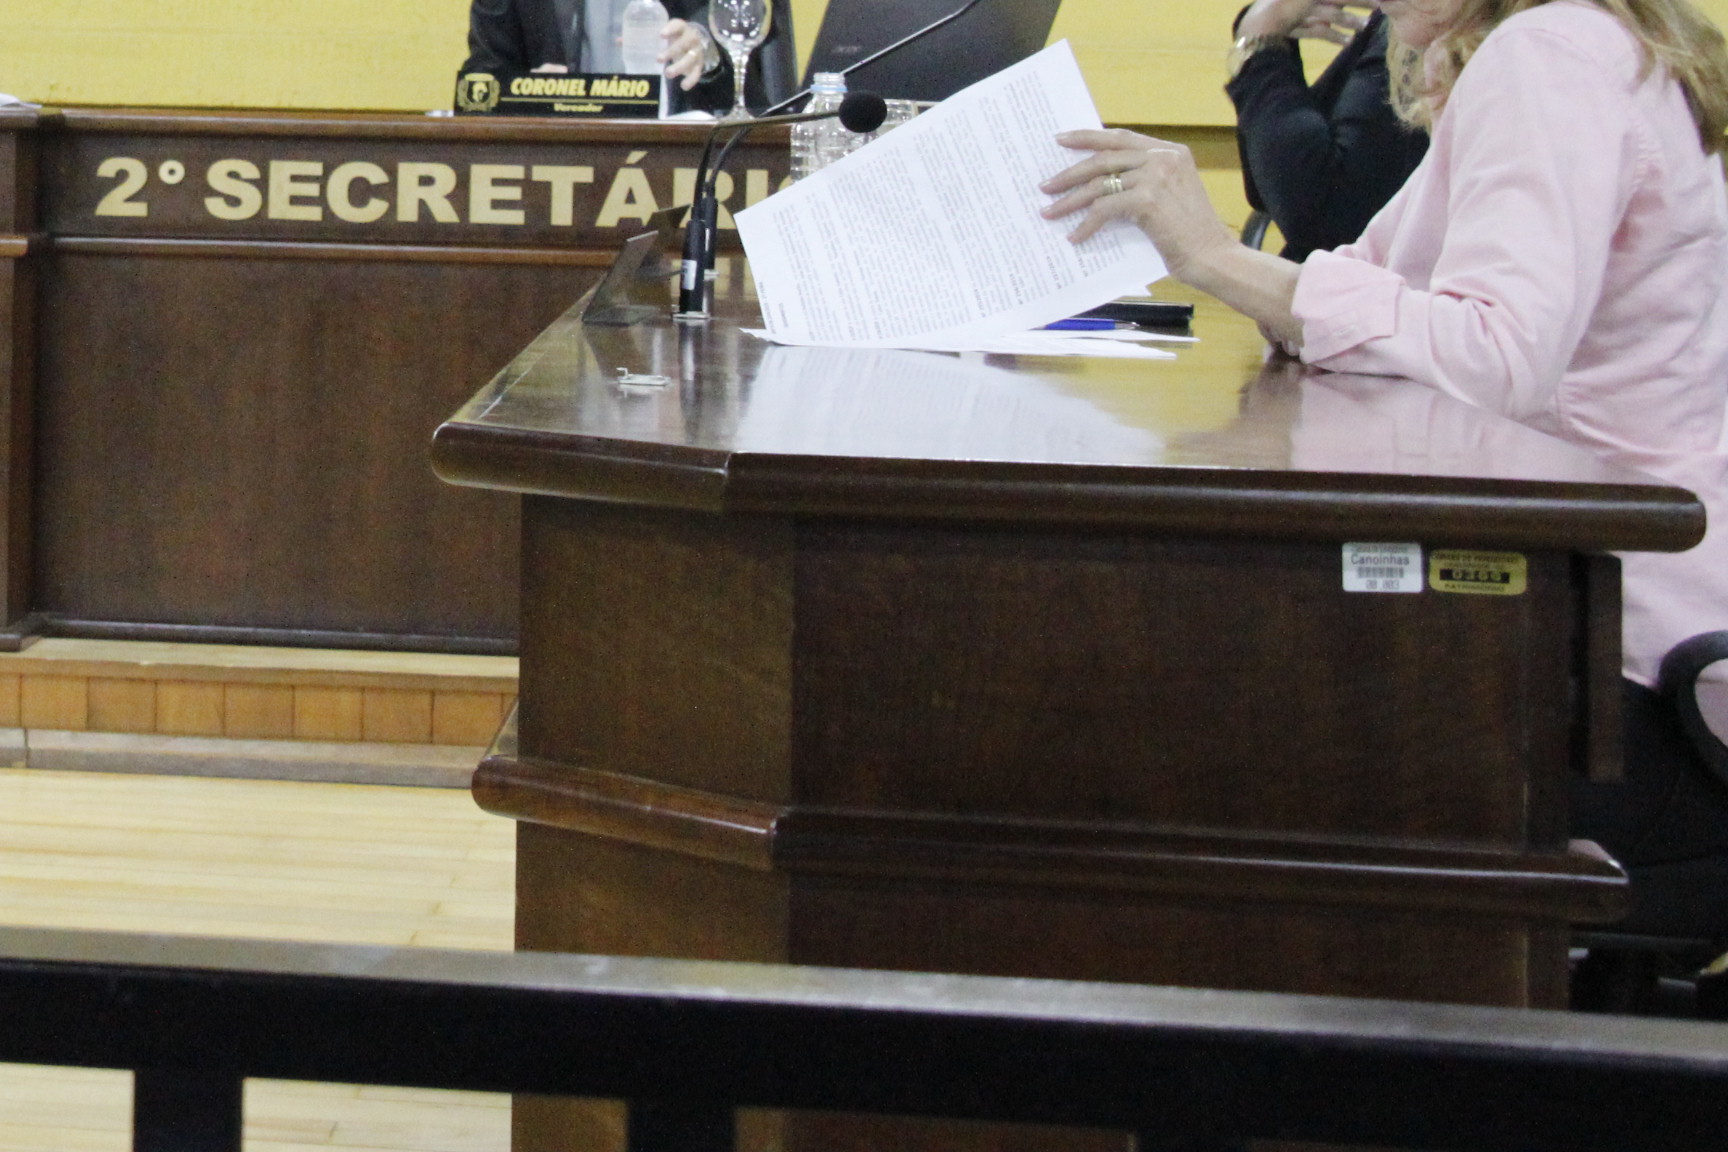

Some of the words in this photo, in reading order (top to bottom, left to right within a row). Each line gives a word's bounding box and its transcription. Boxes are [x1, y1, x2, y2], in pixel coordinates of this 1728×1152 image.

[510, 77, 587, 96] CORONEL
[589, 75, 651, 98] MÁRIO
[204, 151, 792, 229] SECRETÁRI
[1351, 553, 1409, 565] Canoinhas
